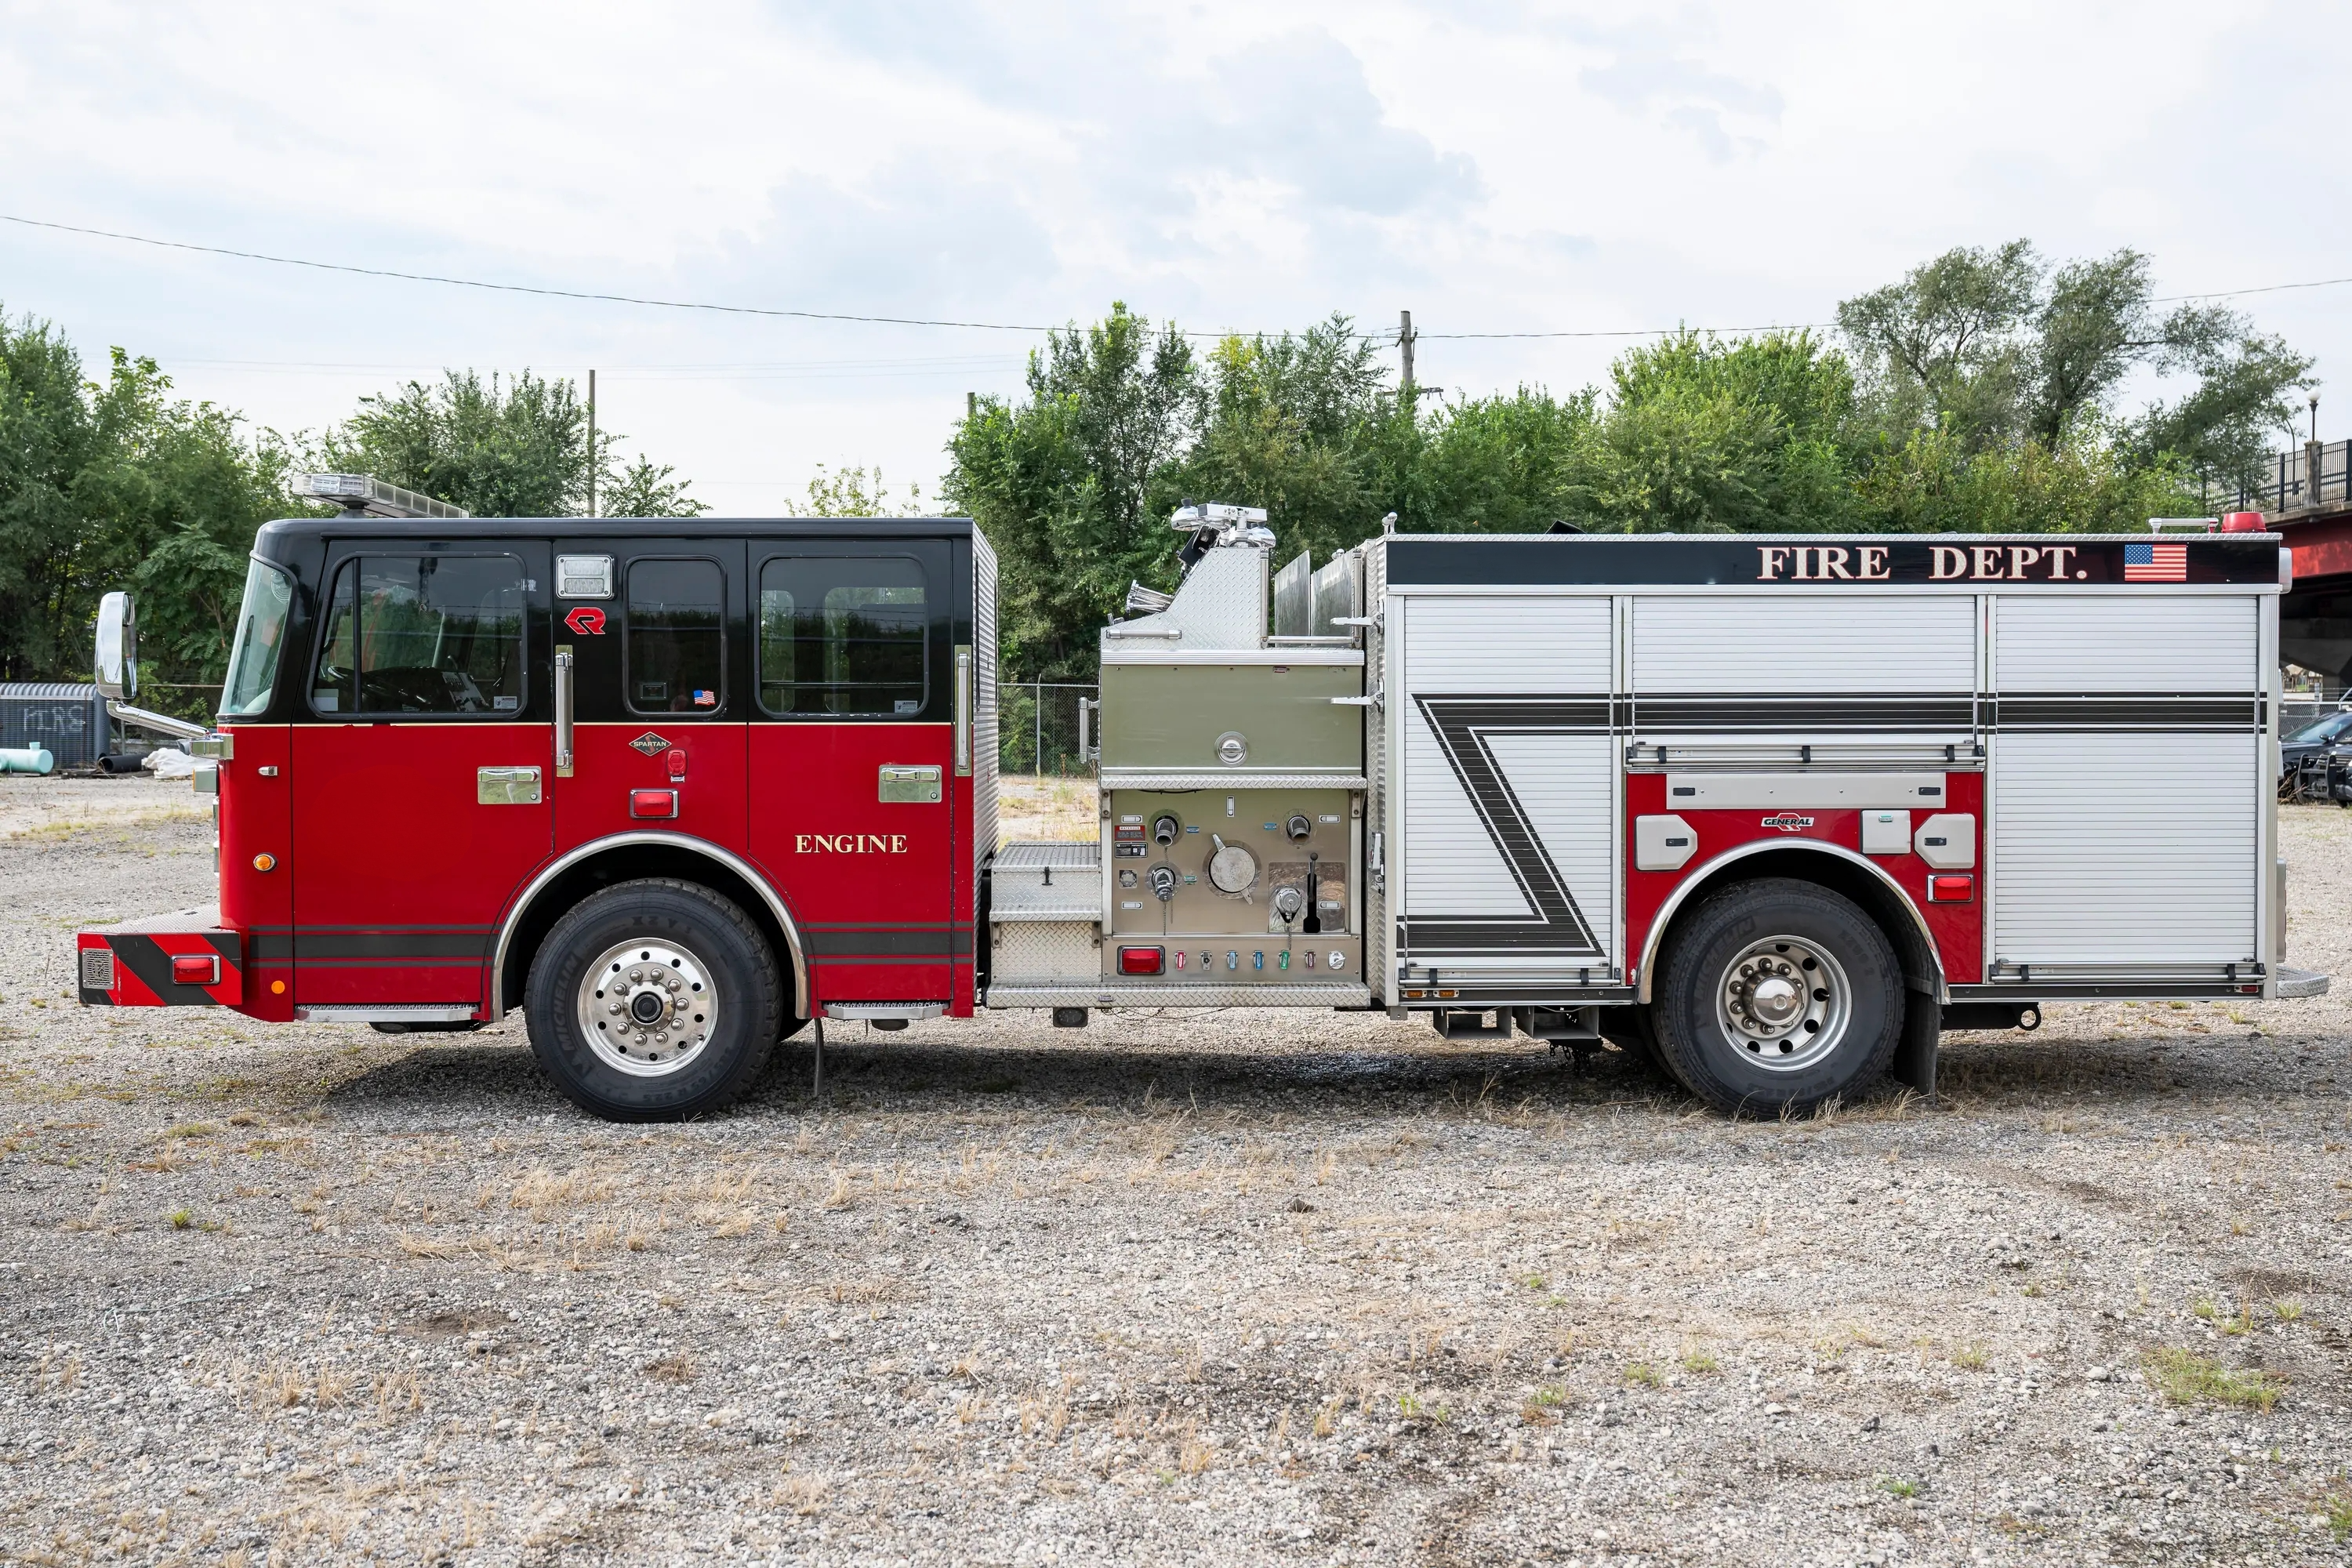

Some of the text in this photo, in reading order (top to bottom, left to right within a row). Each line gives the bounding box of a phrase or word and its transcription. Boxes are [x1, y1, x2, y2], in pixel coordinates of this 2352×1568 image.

[1757, 546, 2088, 579] FIRE DEPT.
[794, 834, 908, 853] ENGINE
[554, 952, 583, 1051] MICHELIN
